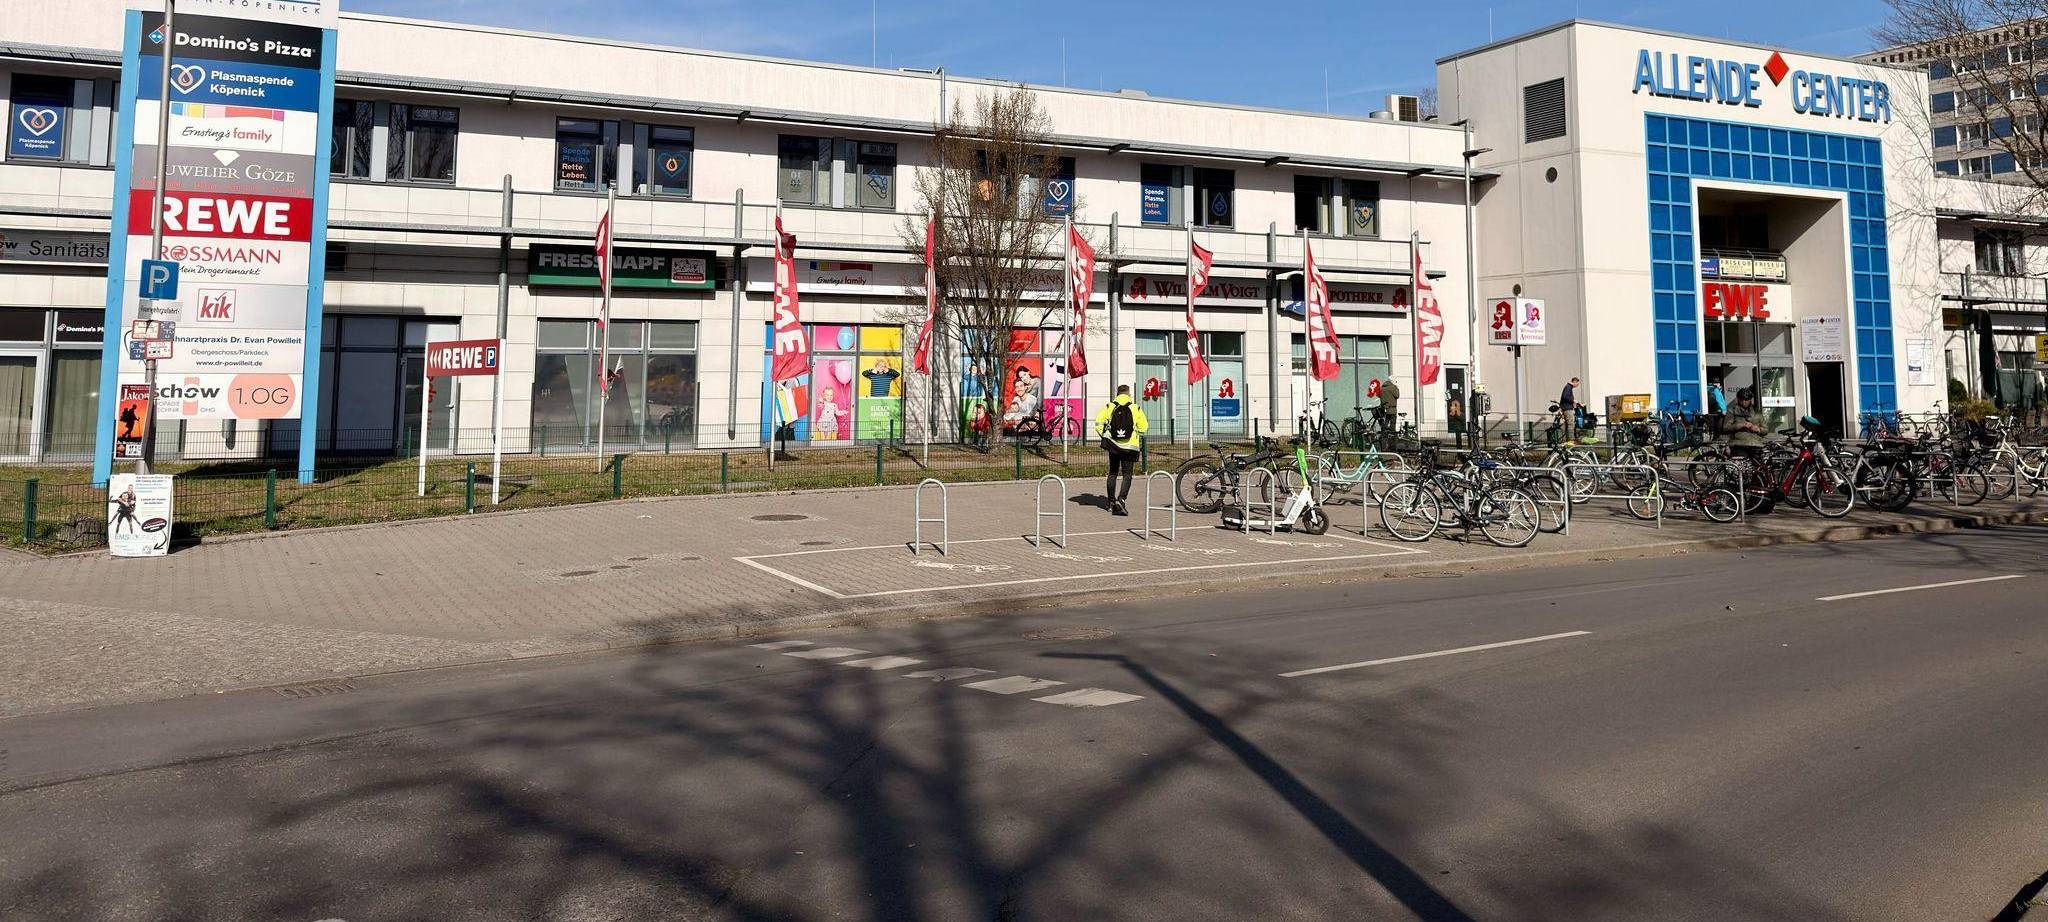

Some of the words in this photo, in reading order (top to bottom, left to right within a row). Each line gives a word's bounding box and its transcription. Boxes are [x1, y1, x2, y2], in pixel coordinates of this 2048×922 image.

[175, 32, 259, 52] Domino's
[264, 40, 312, 58] Pizza
[211, 71, 294, 87] Plasmaspende
[1632, 49, 1762, 107] ALLENDE
[1791, 70, 1891, 123] CENTER
[210, 84, 266, 98] Köpenick
[182, 126, 230, 141] Ernsting's
[233, 127, 272, 143] family
[154, 164, 240, 179] UWELIER
[245, 164, 295, 182] GÖZE
[561, 171, 587, 179] Leben.
[151, 196, 290, 235] REWE
[29, 240, 109, 258] Sanitäts
[148, 265, 170, 293] P
[179, 265, 195, 273] ein
[197, 265, 261, 277] Drogeriemarkt
[844, 276, 867, 285] family
[1153, 281, 1219, 298] WILLM
[1221, 283, 1260, 299] VOIGT
[200, 295, 232, 318] kik
[443, 347, 482, 369] REWE
[487, 350, 495, 364] P
[235, 388, 289, 405] 1.OG
